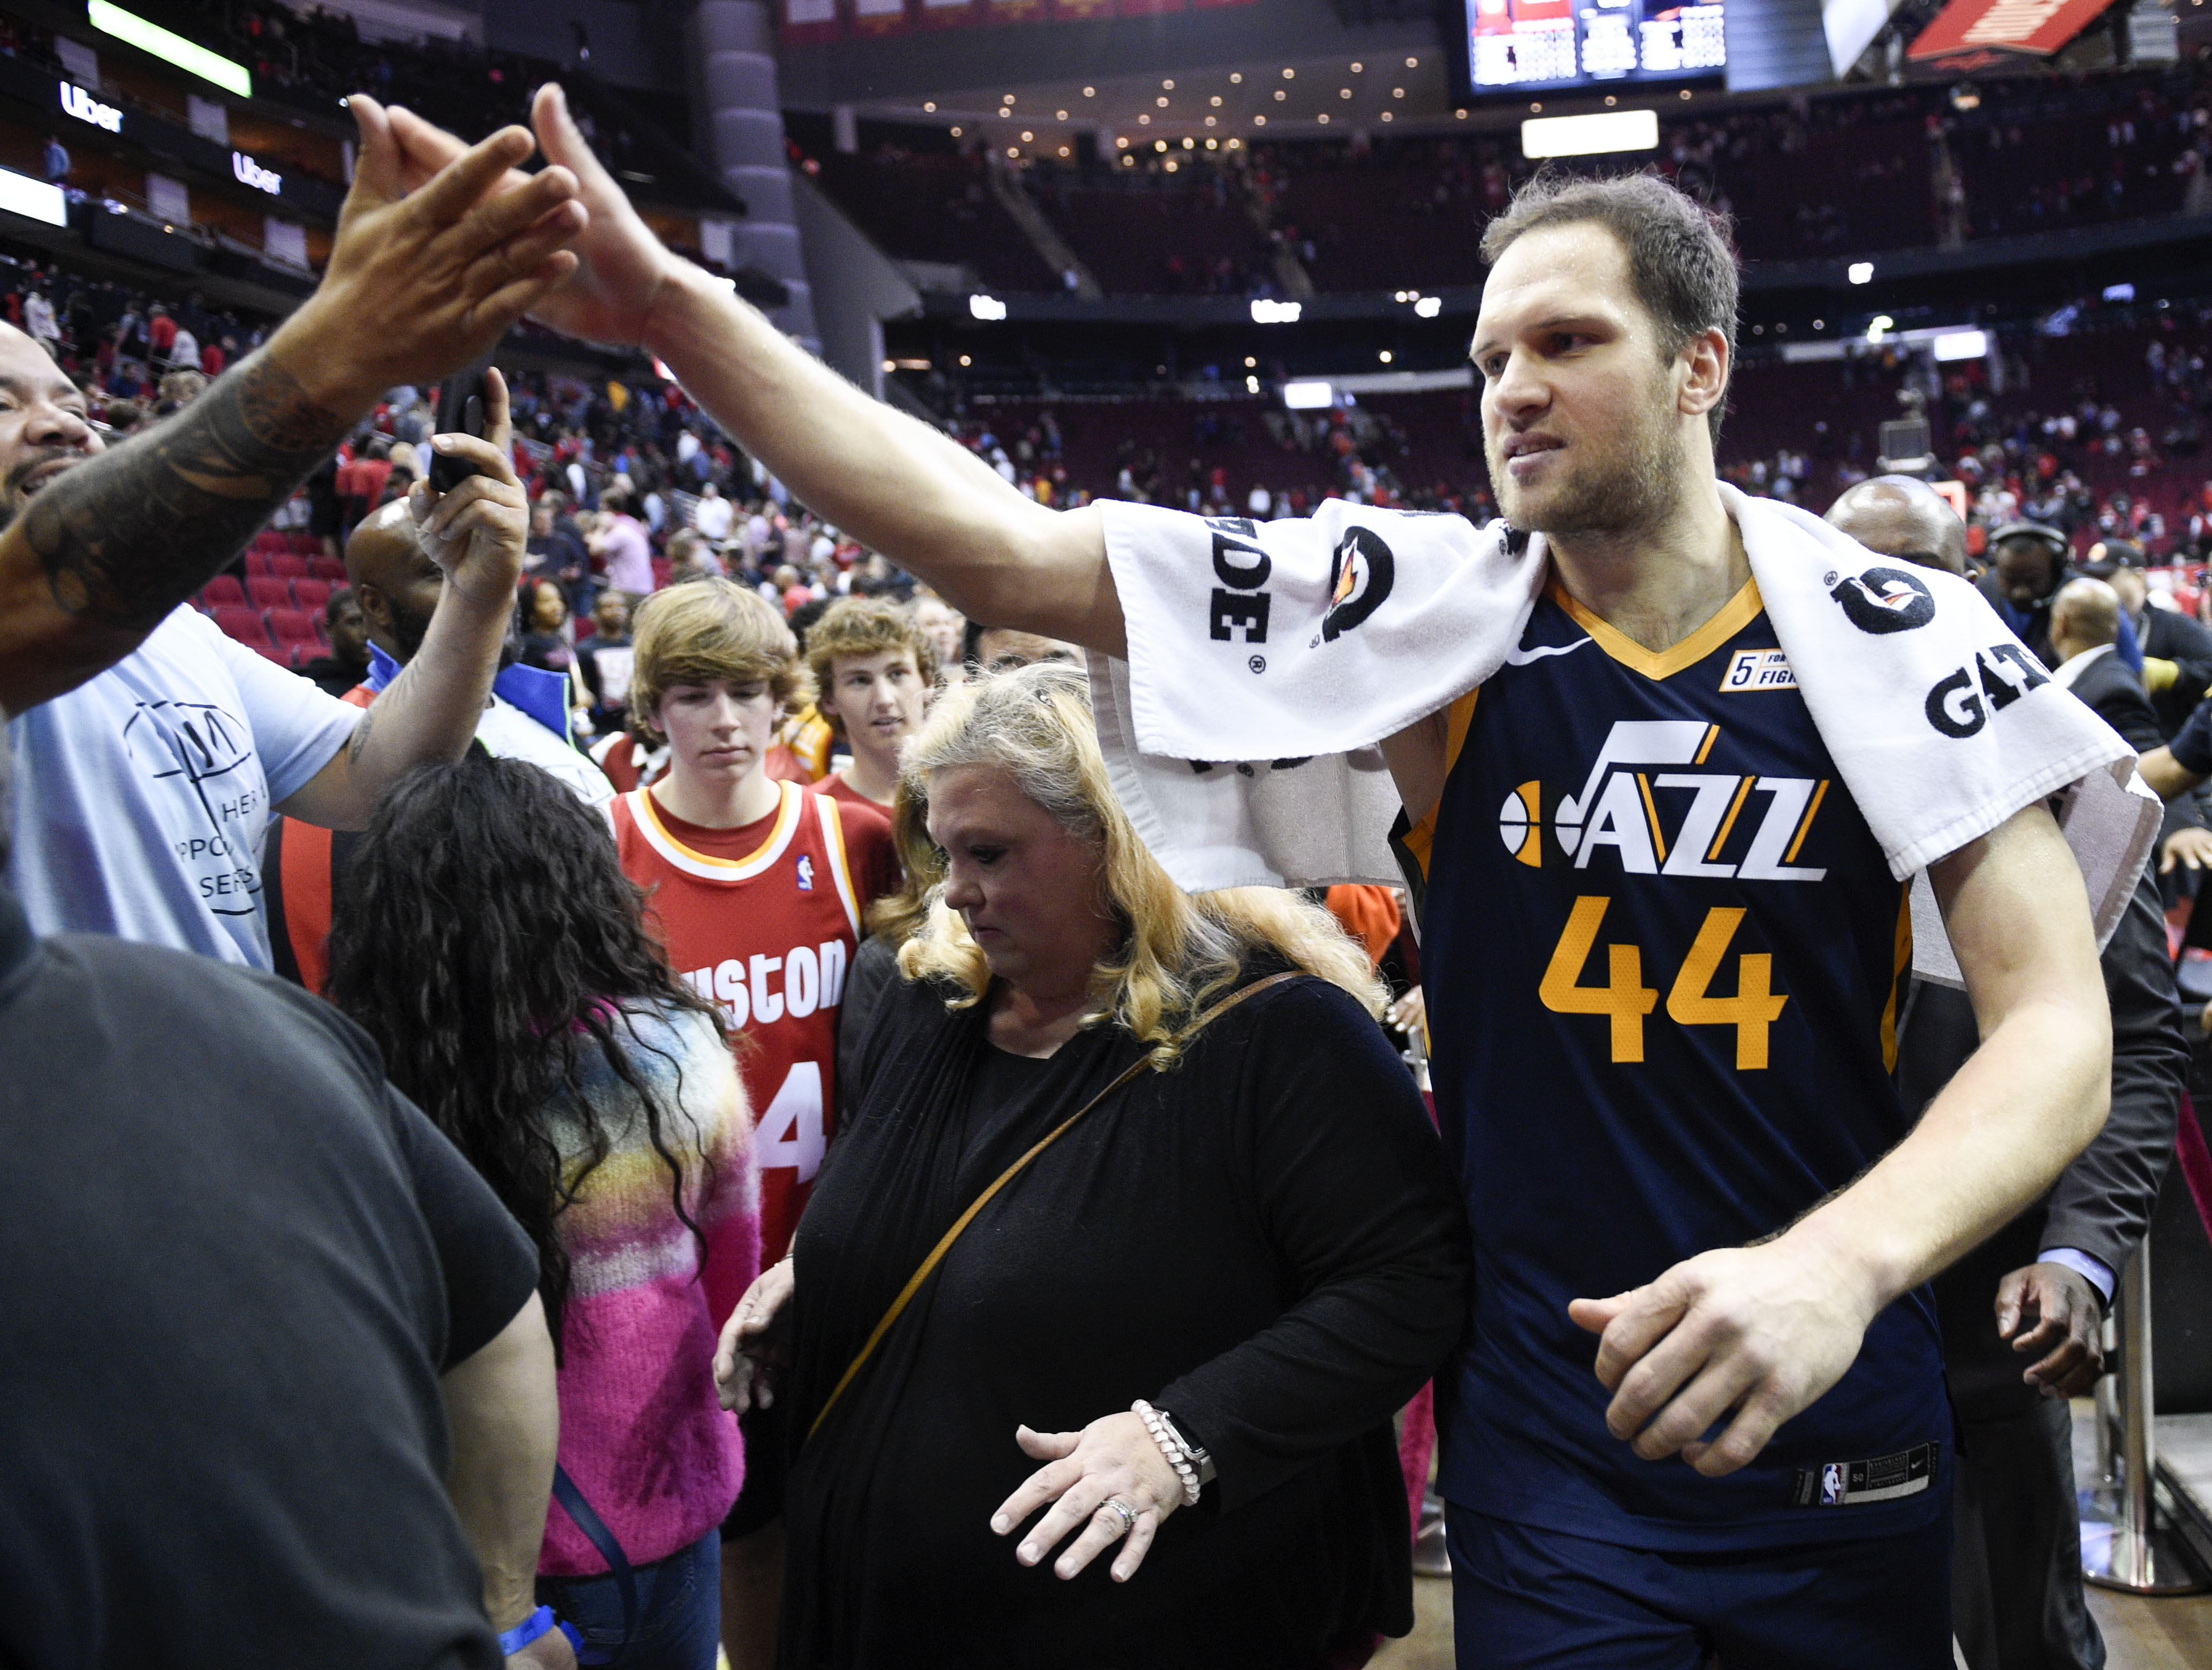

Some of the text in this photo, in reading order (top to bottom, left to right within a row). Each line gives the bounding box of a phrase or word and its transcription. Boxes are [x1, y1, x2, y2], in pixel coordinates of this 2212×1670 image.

[60, 81, 124, 133] Uber
[232, 151, 282, 195] Uber
[1731, 657, 1757, 685] 5
[1759, 670, 1797, 684] FIGH
[1926, 644, 2051, 738] GAT
[1500, 721, 1829, 881] JAZZ
[681, 939, 847, 1030] uston
[1539, 896, 1789, 1070] 44
